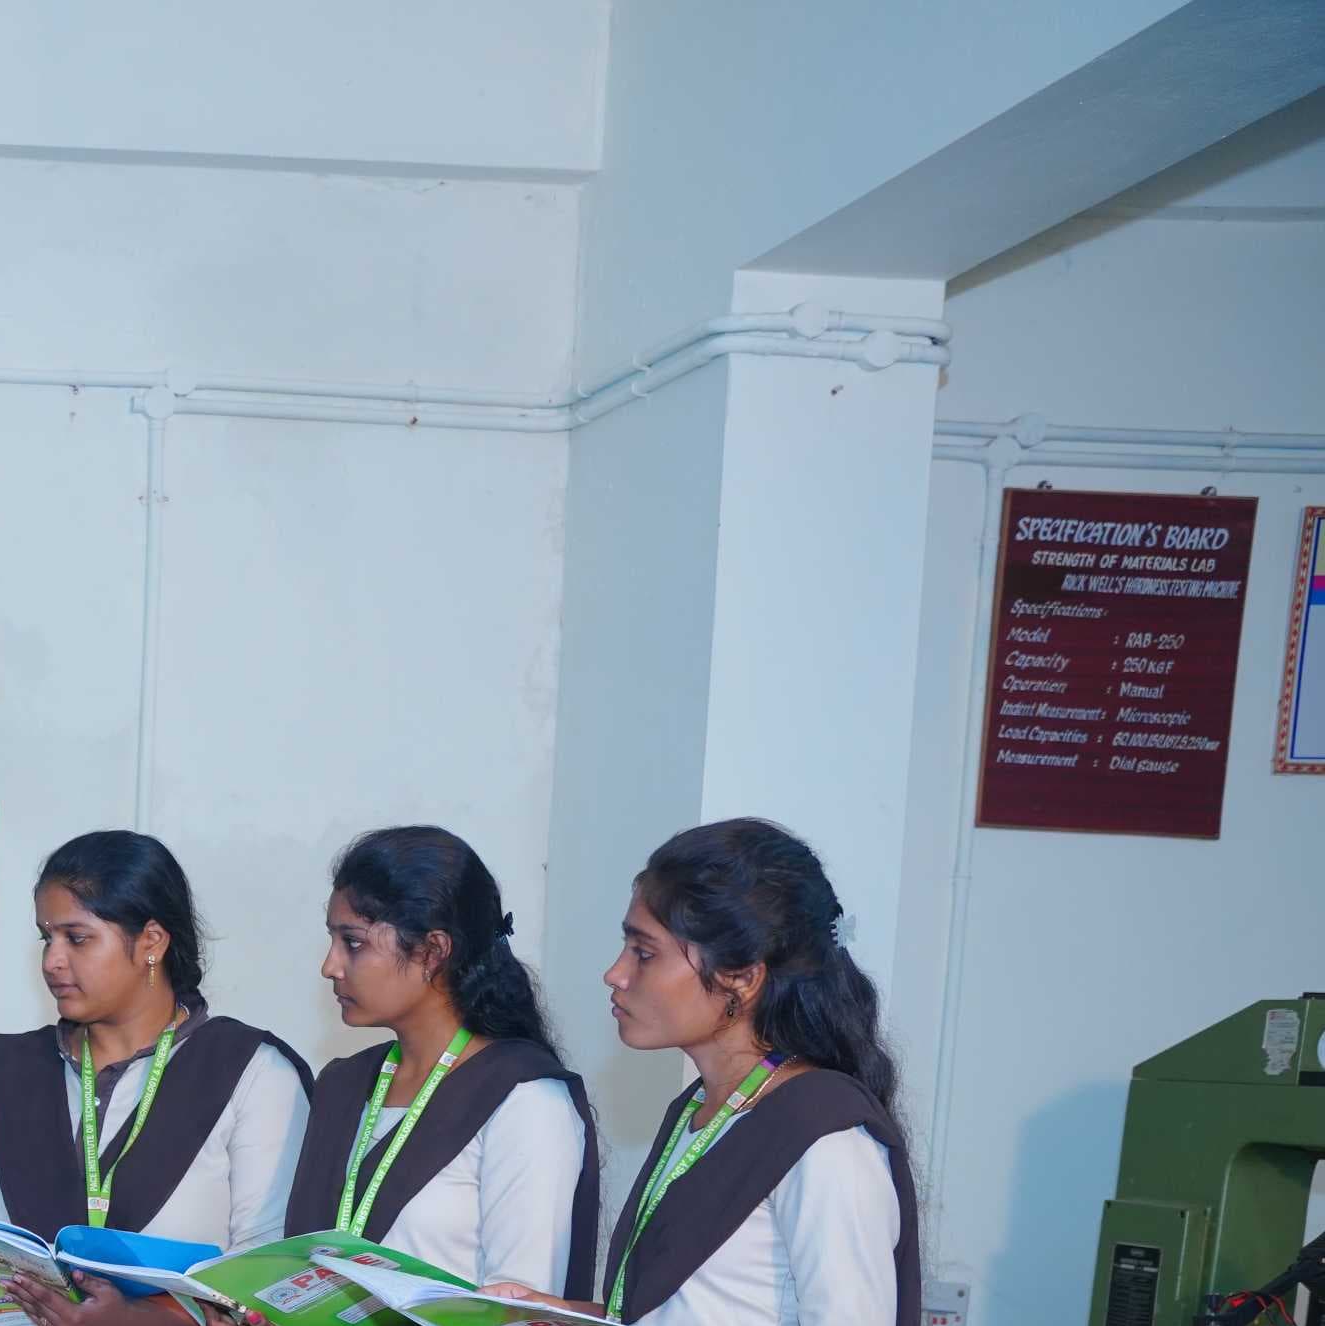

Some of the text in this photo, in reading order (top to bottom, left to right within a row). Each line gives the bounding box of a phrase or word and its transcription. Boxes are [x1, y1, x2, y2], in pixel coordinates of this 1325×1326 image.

[1016, 517, 1229, 550] SPECIFICATION'S BOARD
[1032, 551, 1216, 573] STRENGTH OF MATERIALS LAB
[1007, 627, 1050, 644] Model
[1005, 651, 1069, 671] Capacity
[1002, 676, 1164, 699] Operation Manual
[1116, 706, 1191, 727] Microscopic
[998, 724, 1027, 741] Load
[1028, 725, 1088, 744] Capacities
[996, 749, 1179, 775] Measurement Dial gauge
[82, 1075, 93, 1125] TECHNOLOGY
[370, 1078, 391, 1117] SCIENCES
[692, 1110, 728, 1154] SCIENCES
[85, 1137, 98, 1174] INSTITUTE
[358, 1181, 380, 1227] INSTITUTE
[383, 1115, 417, 1171] TECHNOLOGY
[417, 1069, 447, 1110] SCIENCES
[89, 1172, 99, 1192] PACE
